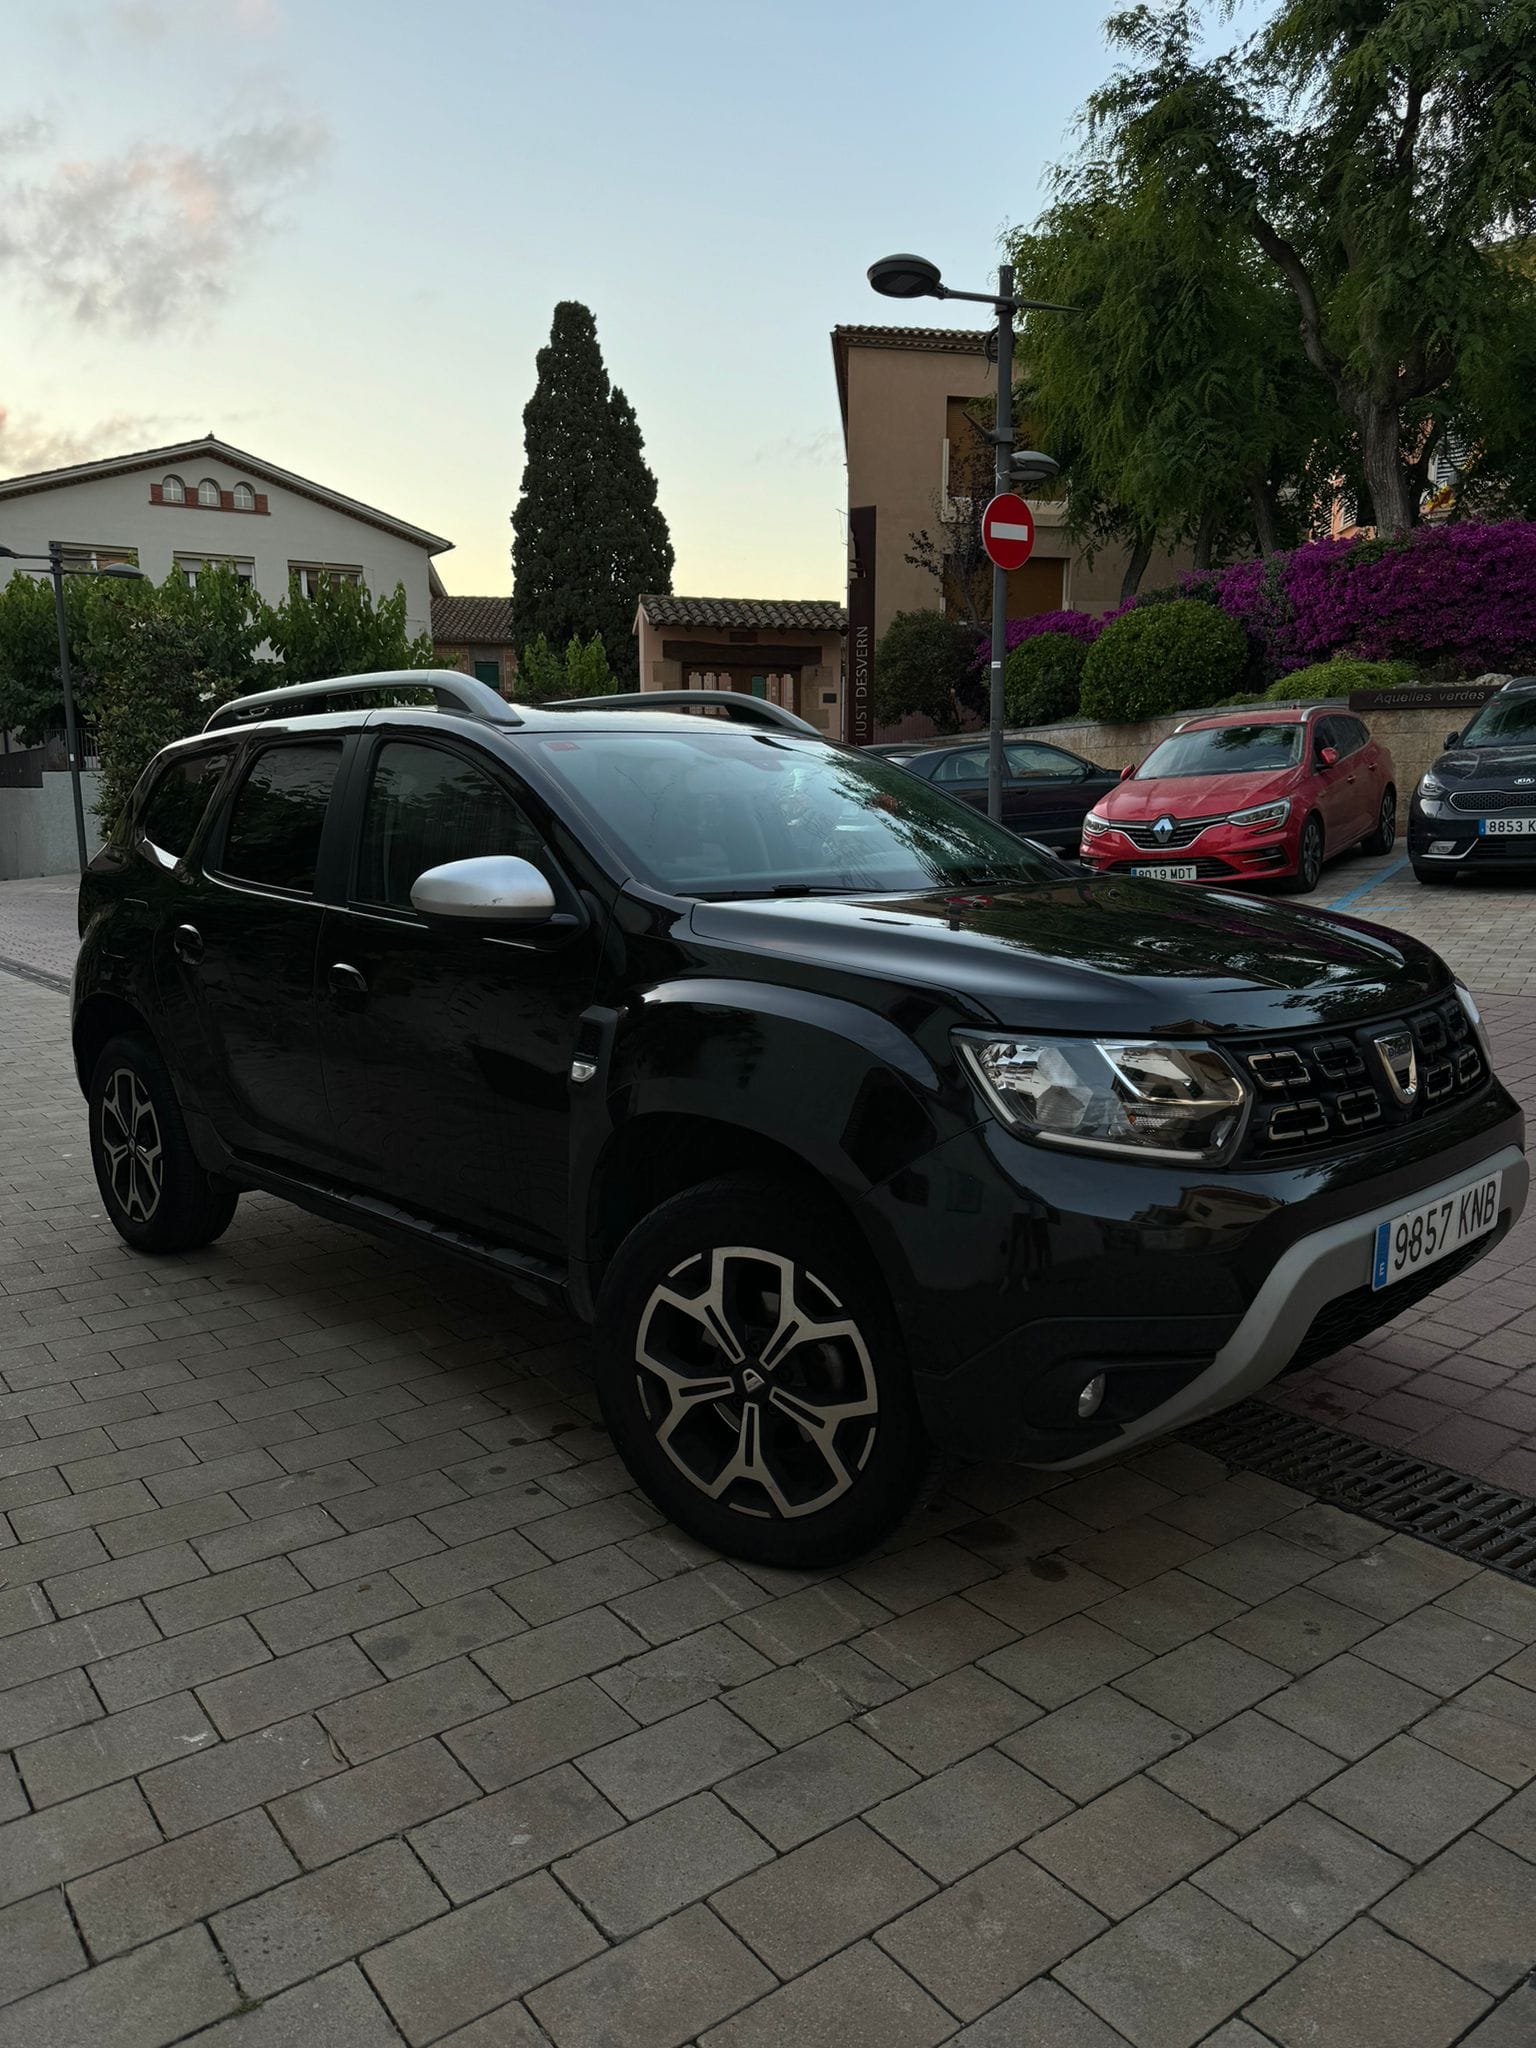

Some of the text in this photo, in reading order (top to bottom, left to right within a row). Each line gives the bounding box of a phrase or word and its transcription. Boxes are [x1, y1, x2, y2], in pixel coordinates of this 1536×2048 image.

[855, 626, 868, 739] JUST DESVERN
[1439, 690, 1485, 701] verdes
[1489, 820, 1523, 833] 8853
[1170, 867, 1193, 880] MDT
[1394, 1180, 1497, 1270] 9857 KNB
